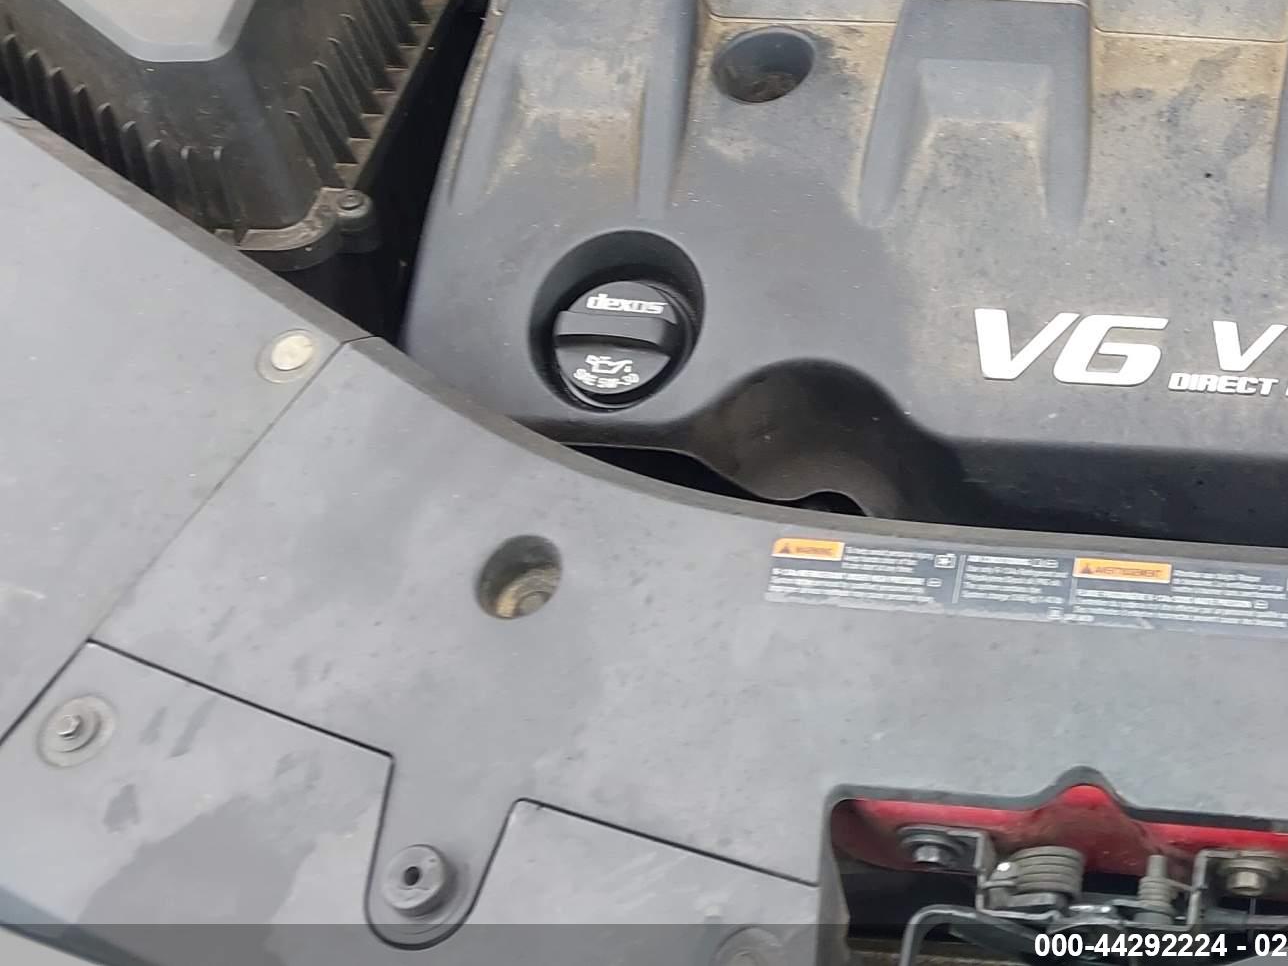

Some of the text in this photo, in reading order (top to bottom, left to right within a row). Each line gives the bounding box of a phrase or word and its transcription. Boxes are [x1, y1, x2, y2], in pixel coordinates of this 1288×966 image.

[586, 293, 668, 315] dexos
[974, 307, 1169, 387] V6
[1168, 371, 1279, 397] DIRECT
